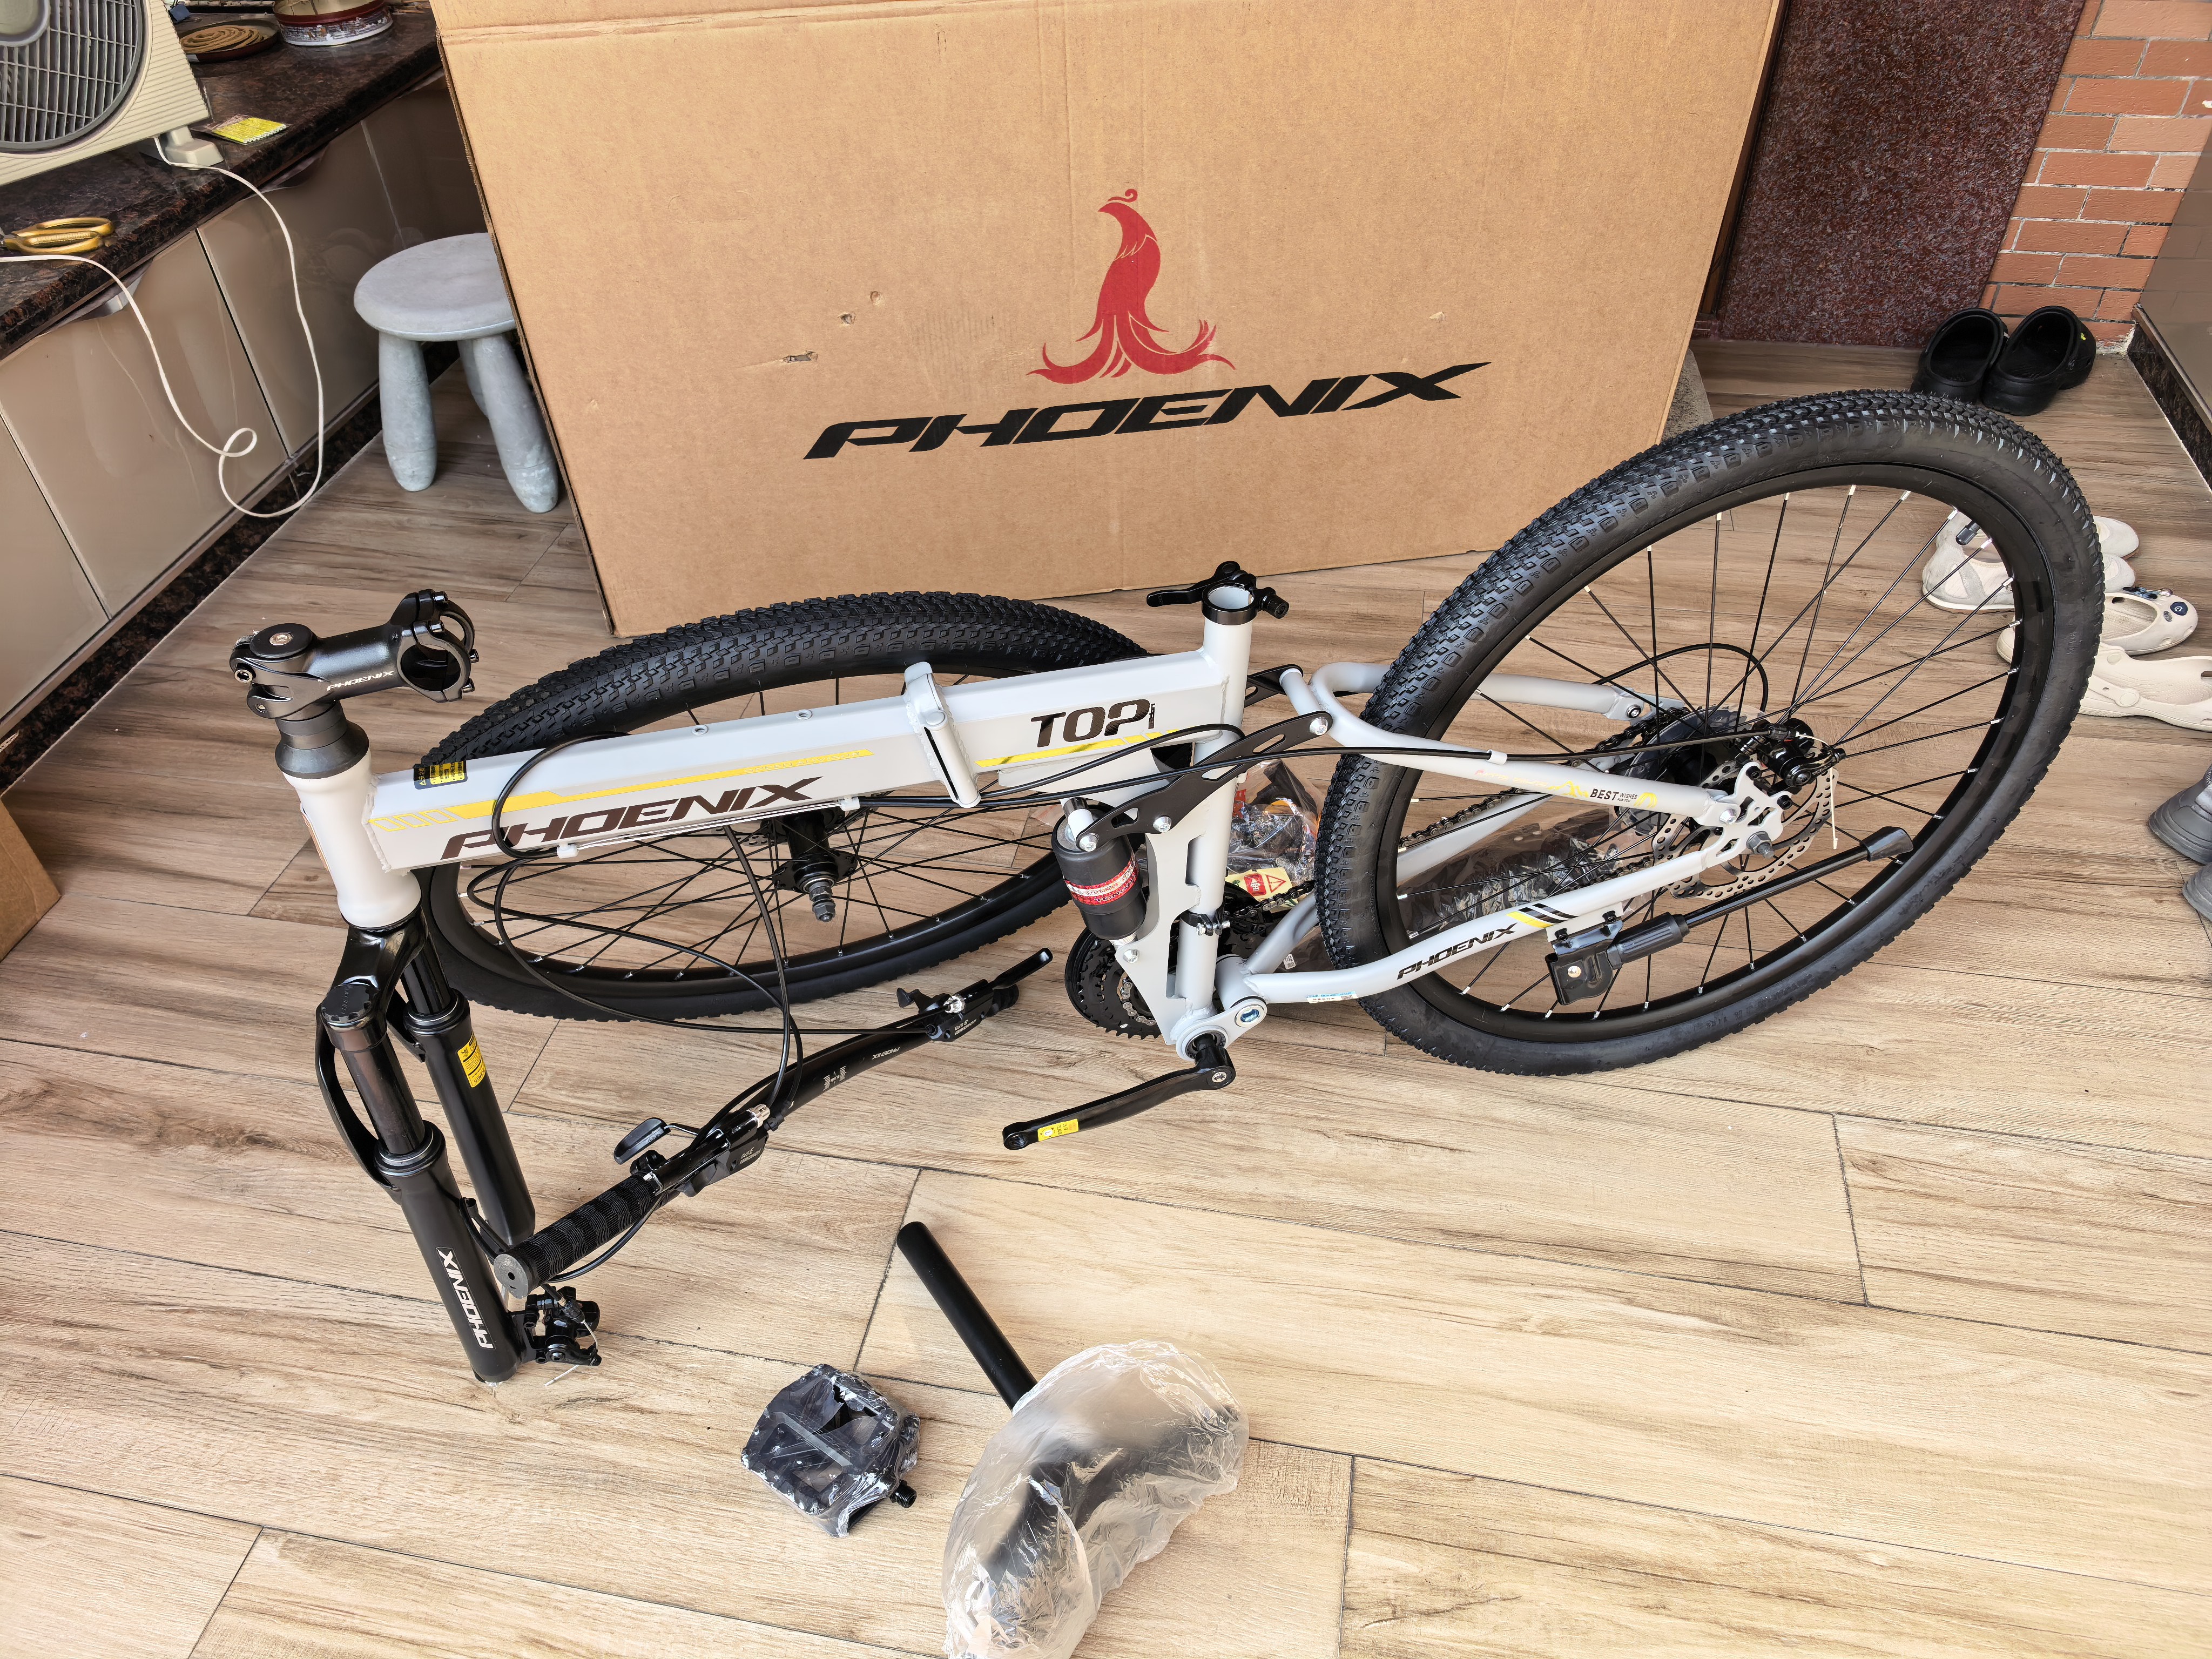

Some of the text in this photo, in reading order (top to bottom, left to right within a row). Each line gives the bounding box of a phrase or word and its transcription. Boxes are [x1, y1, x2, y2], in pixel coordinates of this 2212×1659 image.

[804, 362, 1492, 459] PHOENIX
[327, 671, 394, 691] PHOENIX
[441, 776, 824, 860] PHOENIX
[1589, 788, 1638, 801] BEST WISHES
[1397, 922, 1518, 980] PHOENIX
[871, 1047, 900, 1060] PHOENIX
[437, 1249, 494, 1349] PHOENIX
